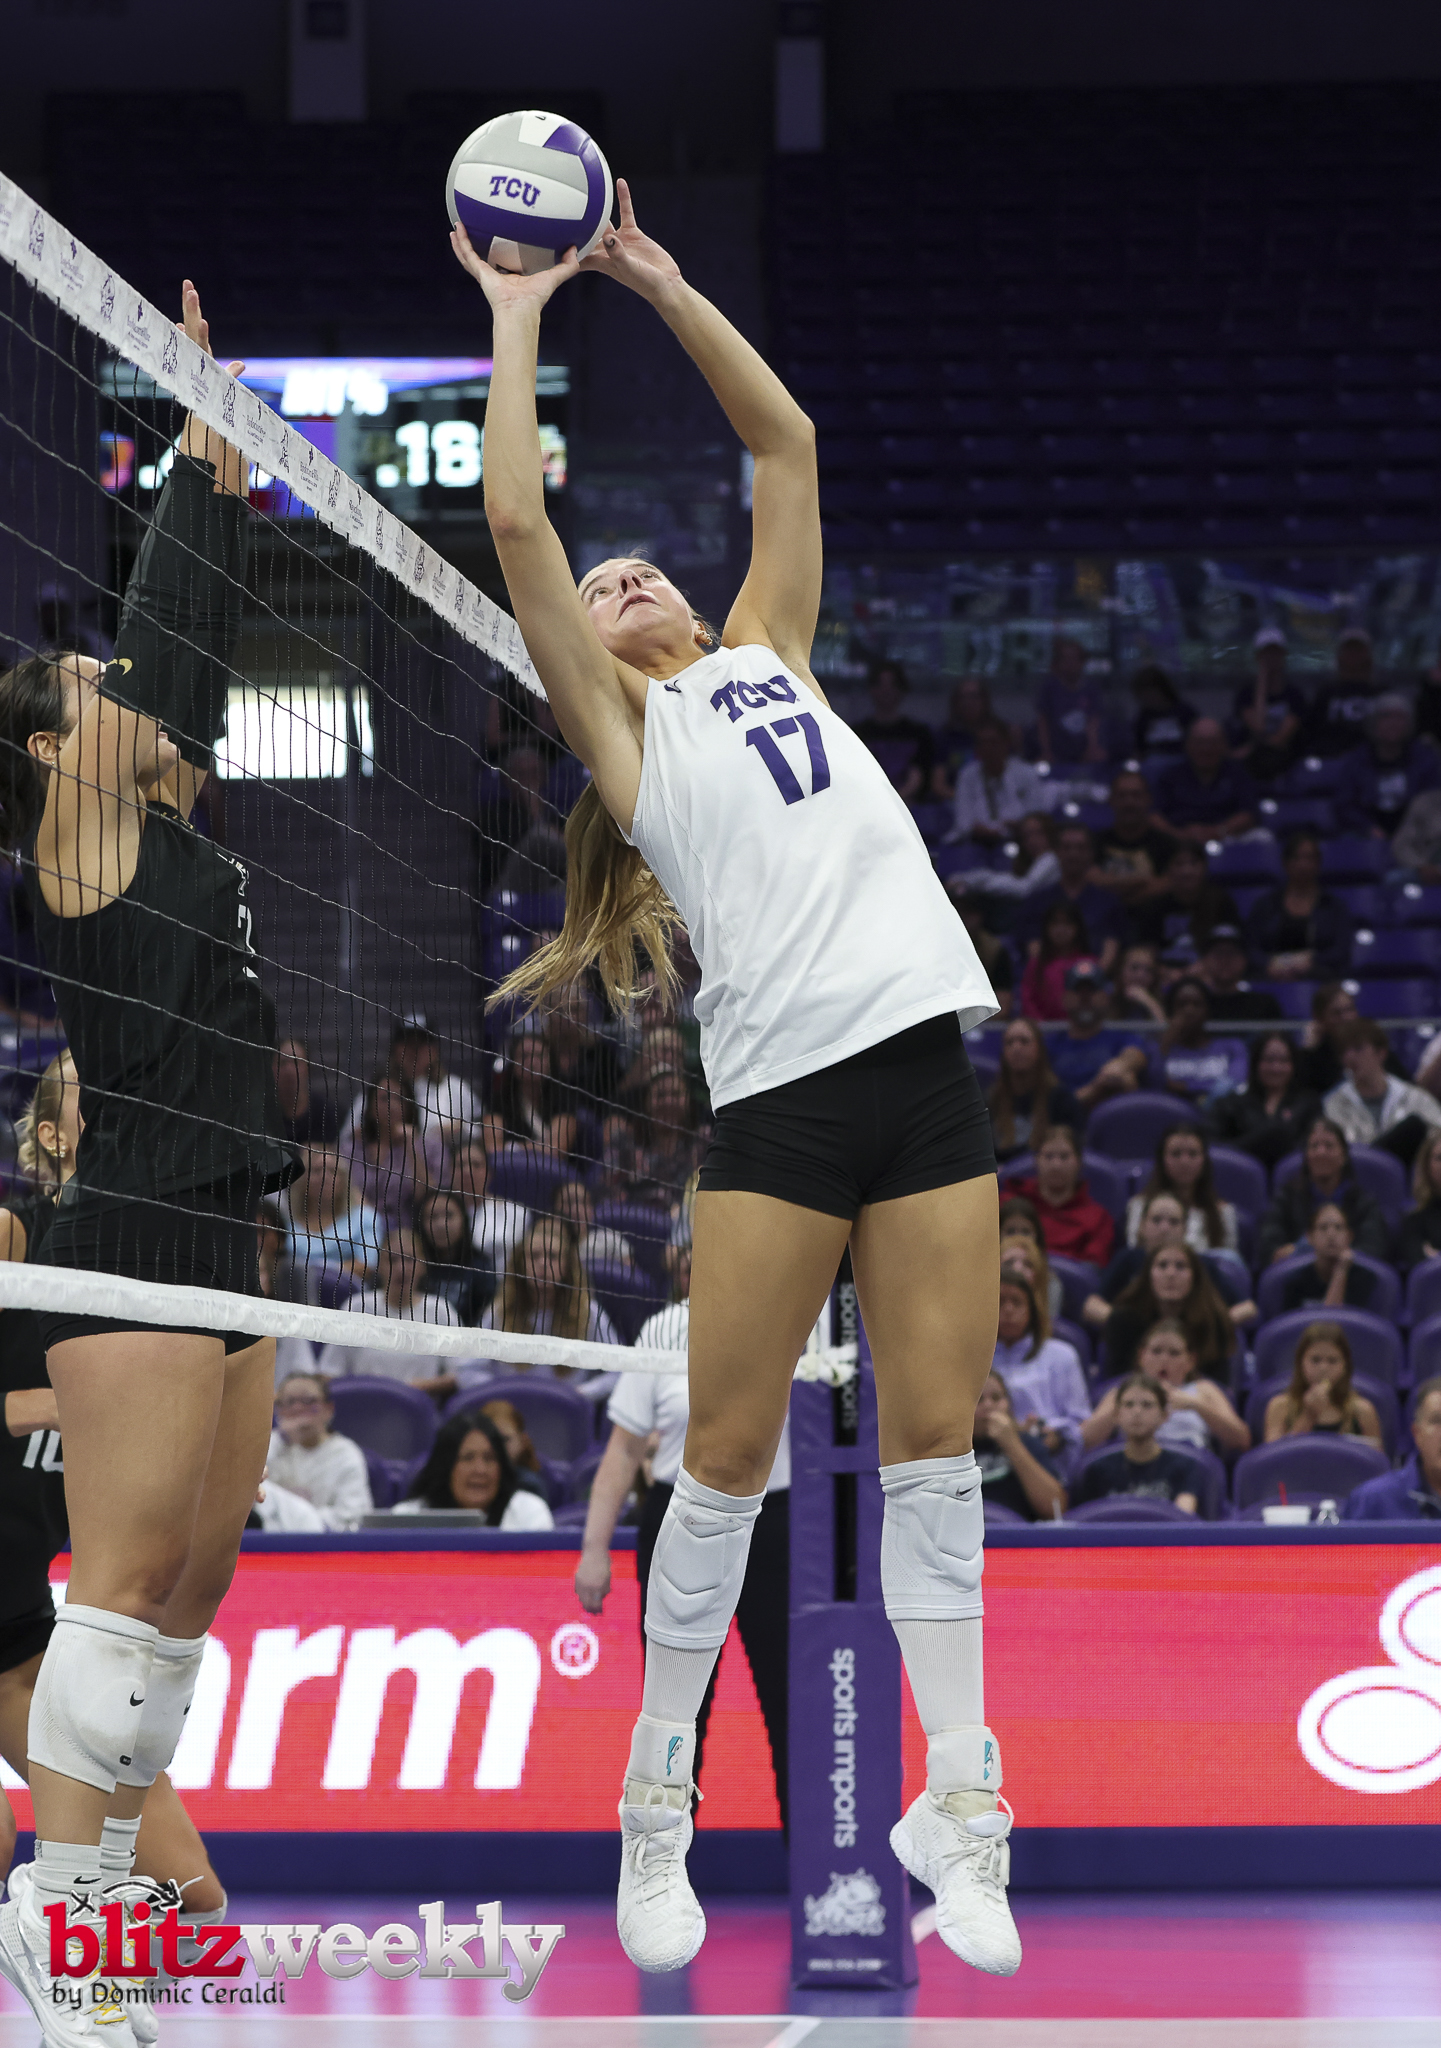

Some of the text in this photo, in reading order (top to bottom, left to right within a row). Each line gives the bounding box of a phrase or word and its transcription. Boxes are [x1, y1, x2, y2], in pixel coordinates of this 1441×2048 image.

[489, 175, 541, 208] TCU
[375, 420, 483, 489] .18
[709, 674, 798, 723] TCU
[745, 711, 831, 806] 17
[827, 1647, 859, 1849] sports imports
